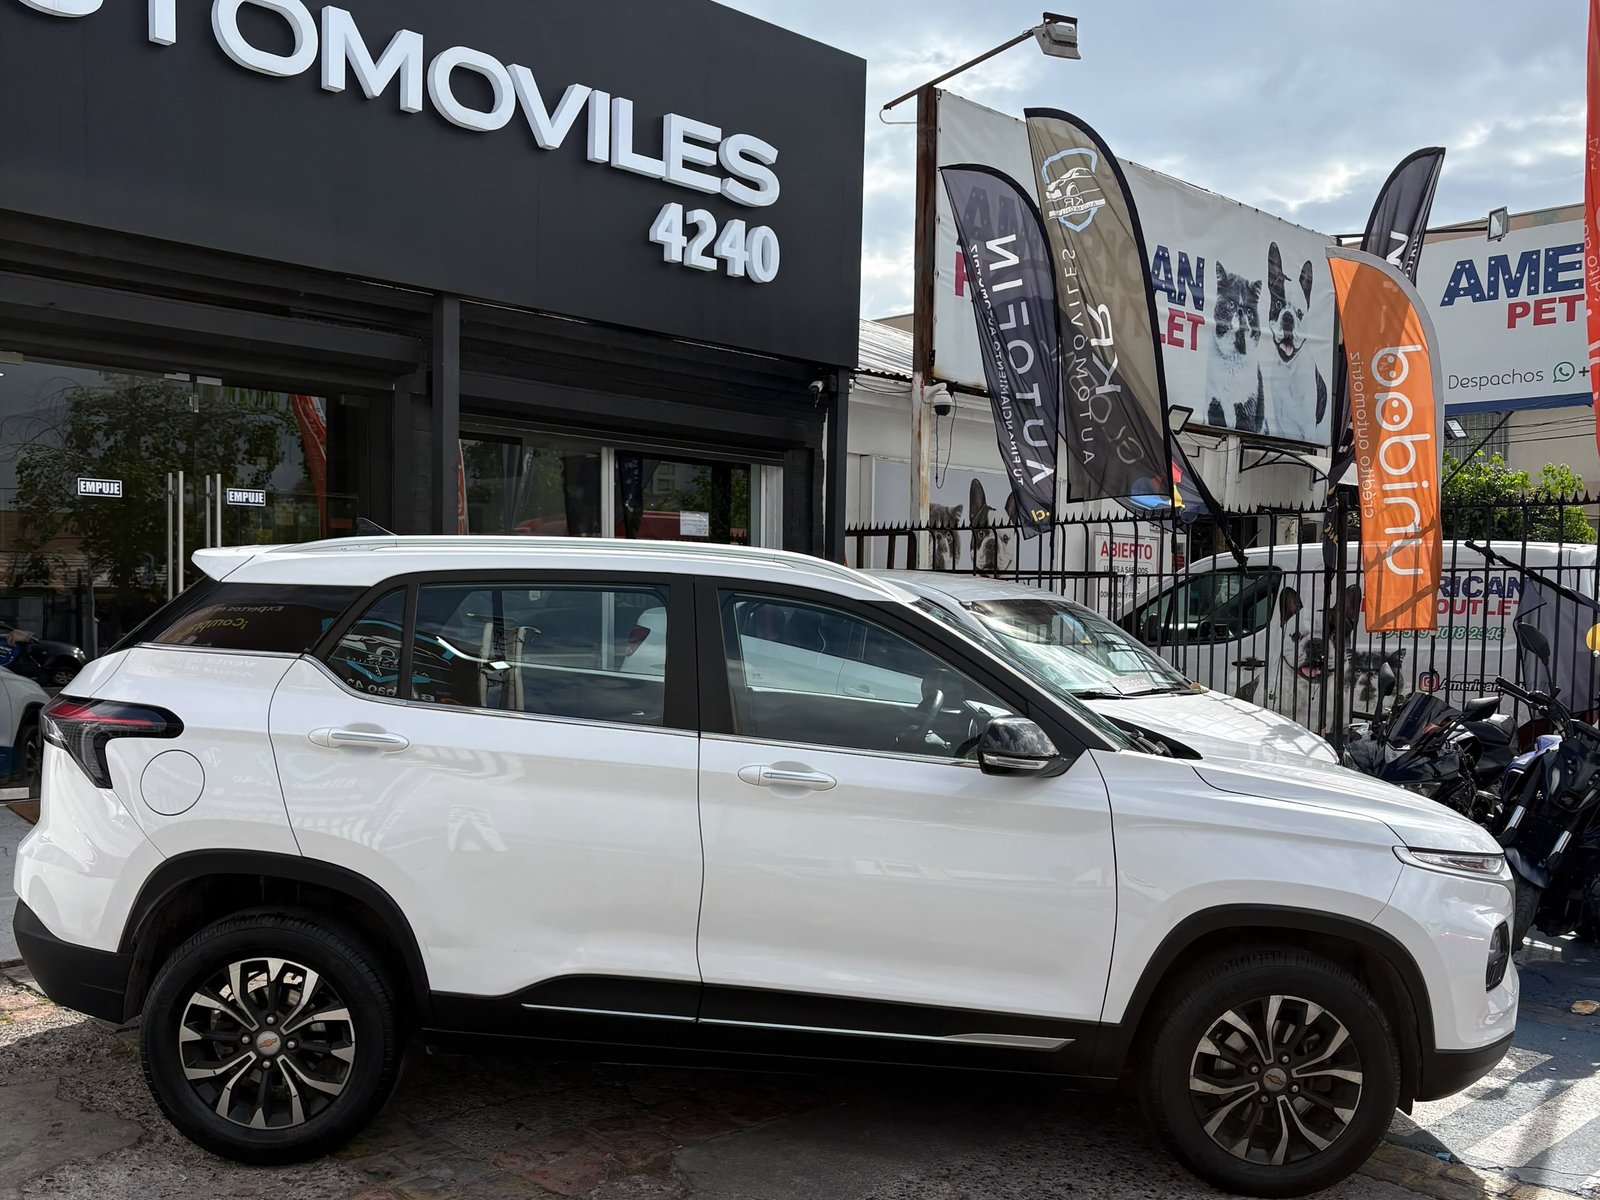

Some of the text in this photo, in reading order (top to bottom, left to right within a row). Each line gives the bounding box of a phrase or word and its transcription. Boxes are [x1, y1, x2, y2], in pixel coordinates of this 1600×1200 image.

[649, 202, 780, 284] 4240
[1507, 294, 1585, 329] PET
[1448, 369, 1544, 391] Despachos
[80, 481, 120, 494] EMPUJE
[229, 491, 264, 504] EMPUJE
[1100, 541, 1153, 560] ABIERTO
